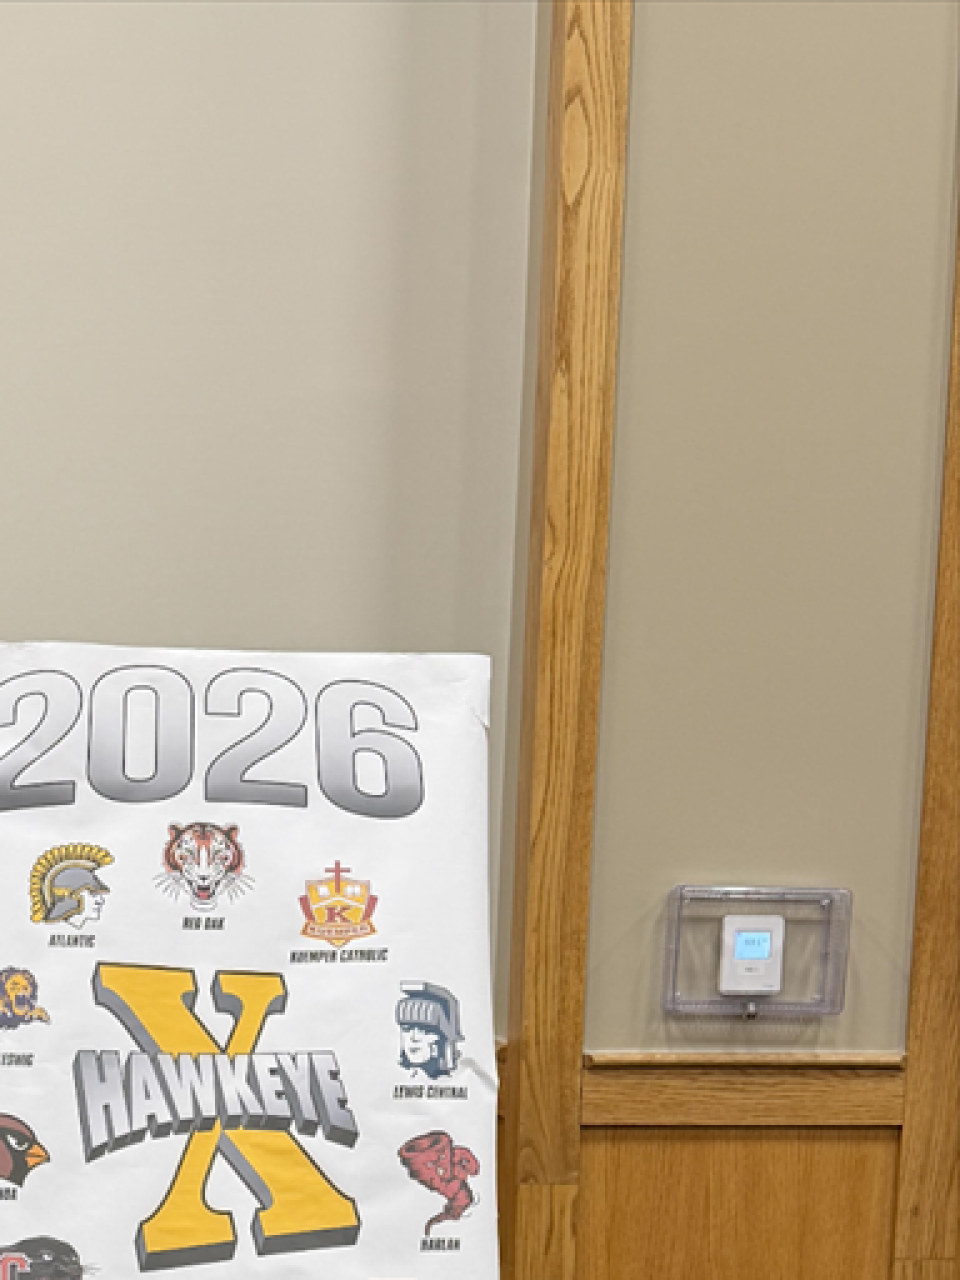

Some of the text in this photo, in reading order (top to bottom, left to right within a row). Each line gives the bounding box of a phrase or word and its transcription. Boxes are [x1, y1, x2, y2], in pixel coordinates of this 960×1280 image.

[48, 934, 96, 948] ATLANTIC
[339, 948, 388, 962] CATHOLIC
[72, 1049, 360, 1164] HAWKEYE
